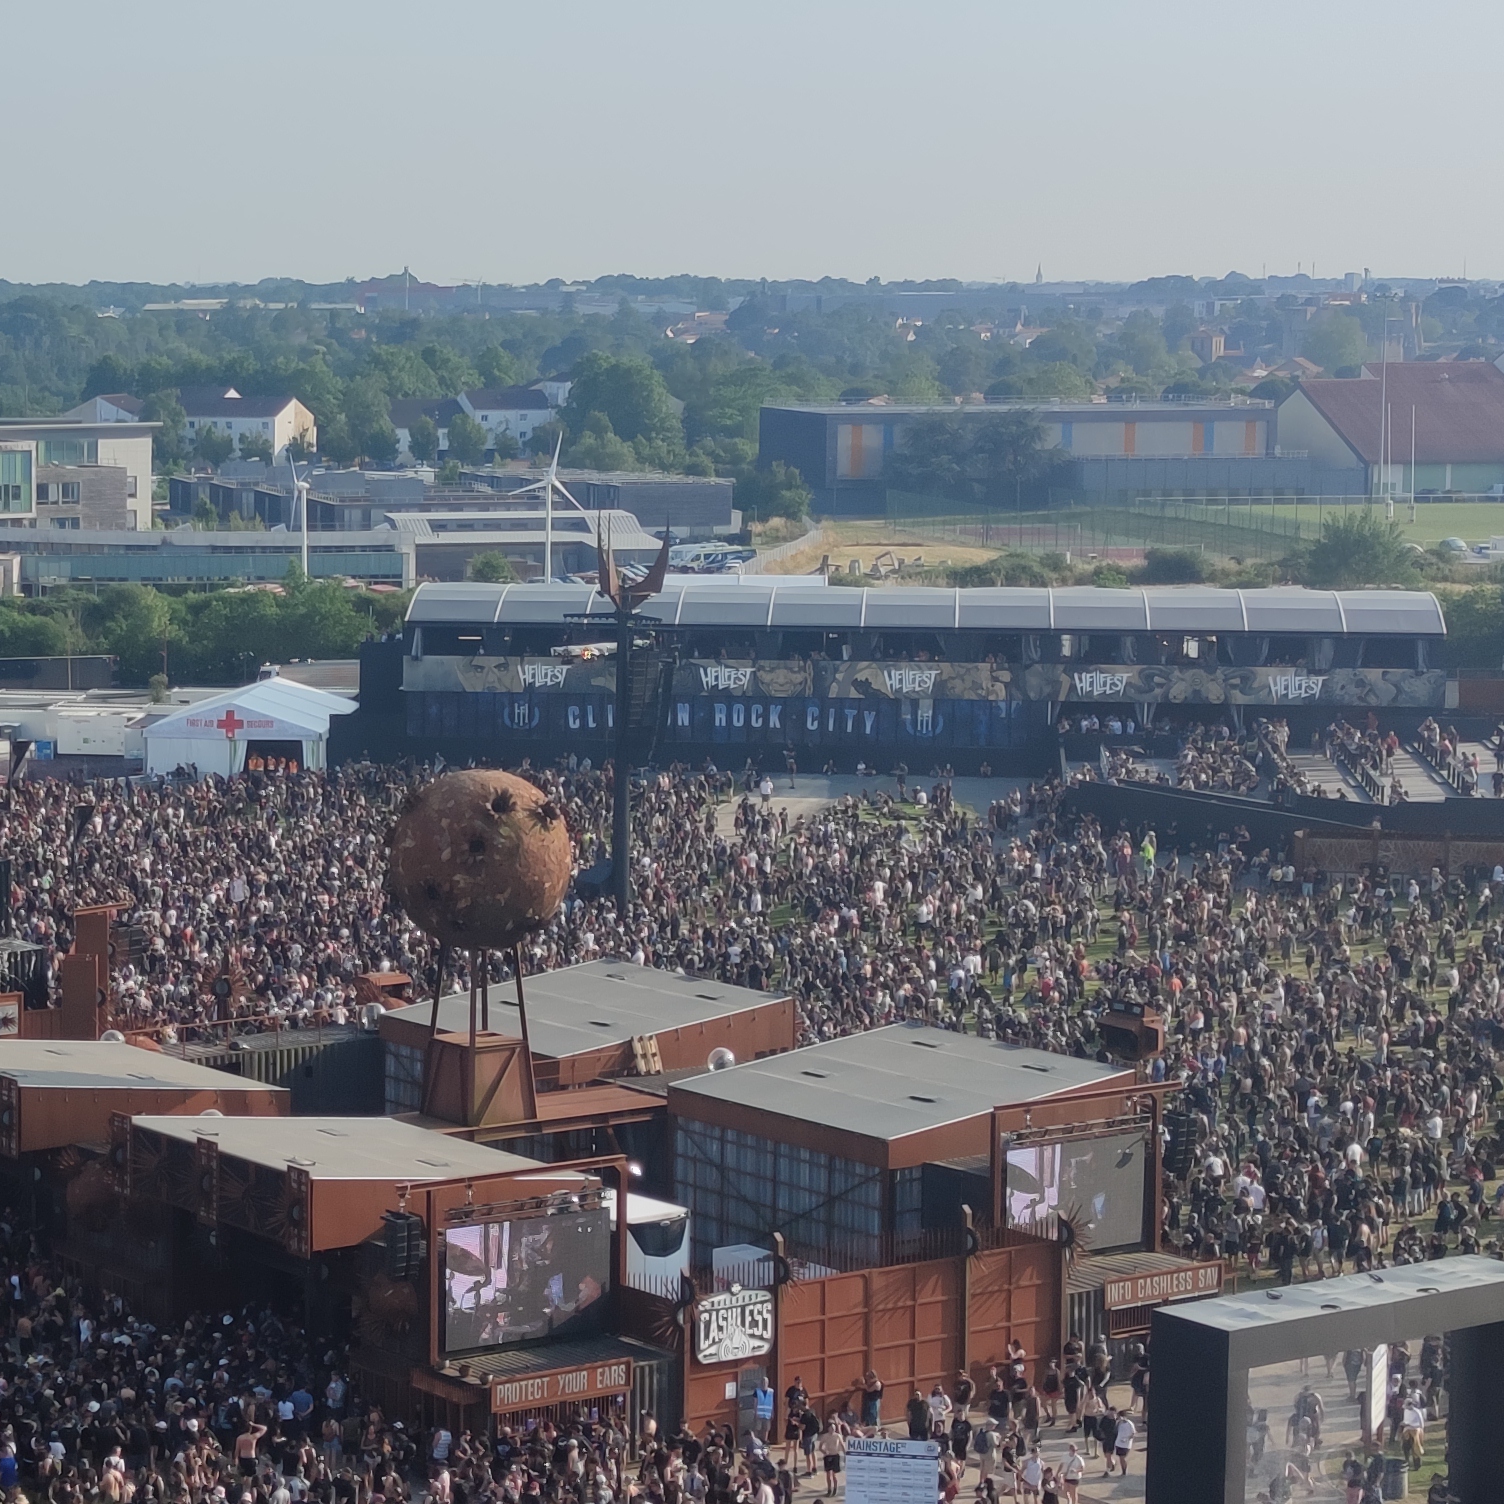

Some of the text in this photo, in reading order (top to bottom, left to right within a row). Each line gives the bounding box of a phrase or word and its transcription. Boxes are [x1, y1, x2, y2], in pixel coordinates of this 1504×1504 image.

[518, 662, 572, 688] HELLFEST
[699, 664, 755, 691] HELLFEST
[883, 665, 940, 693] HELLFEST
[1074, 669, 1133, 697] HELLFEST
[1268, 671, 1329, 700] HELLFEST
[568, 703, 876, 735] CLIN ROCK CITY
[1107, 1267, 1219, 1303] INFO CASHLESS SAV
[699, 1302, 772, 1350] CASHLESS
[496, 1364, 626, 1406] PROTECT YOUR EARS
[847, 1439, 902, 1453] MAINSTAGE
